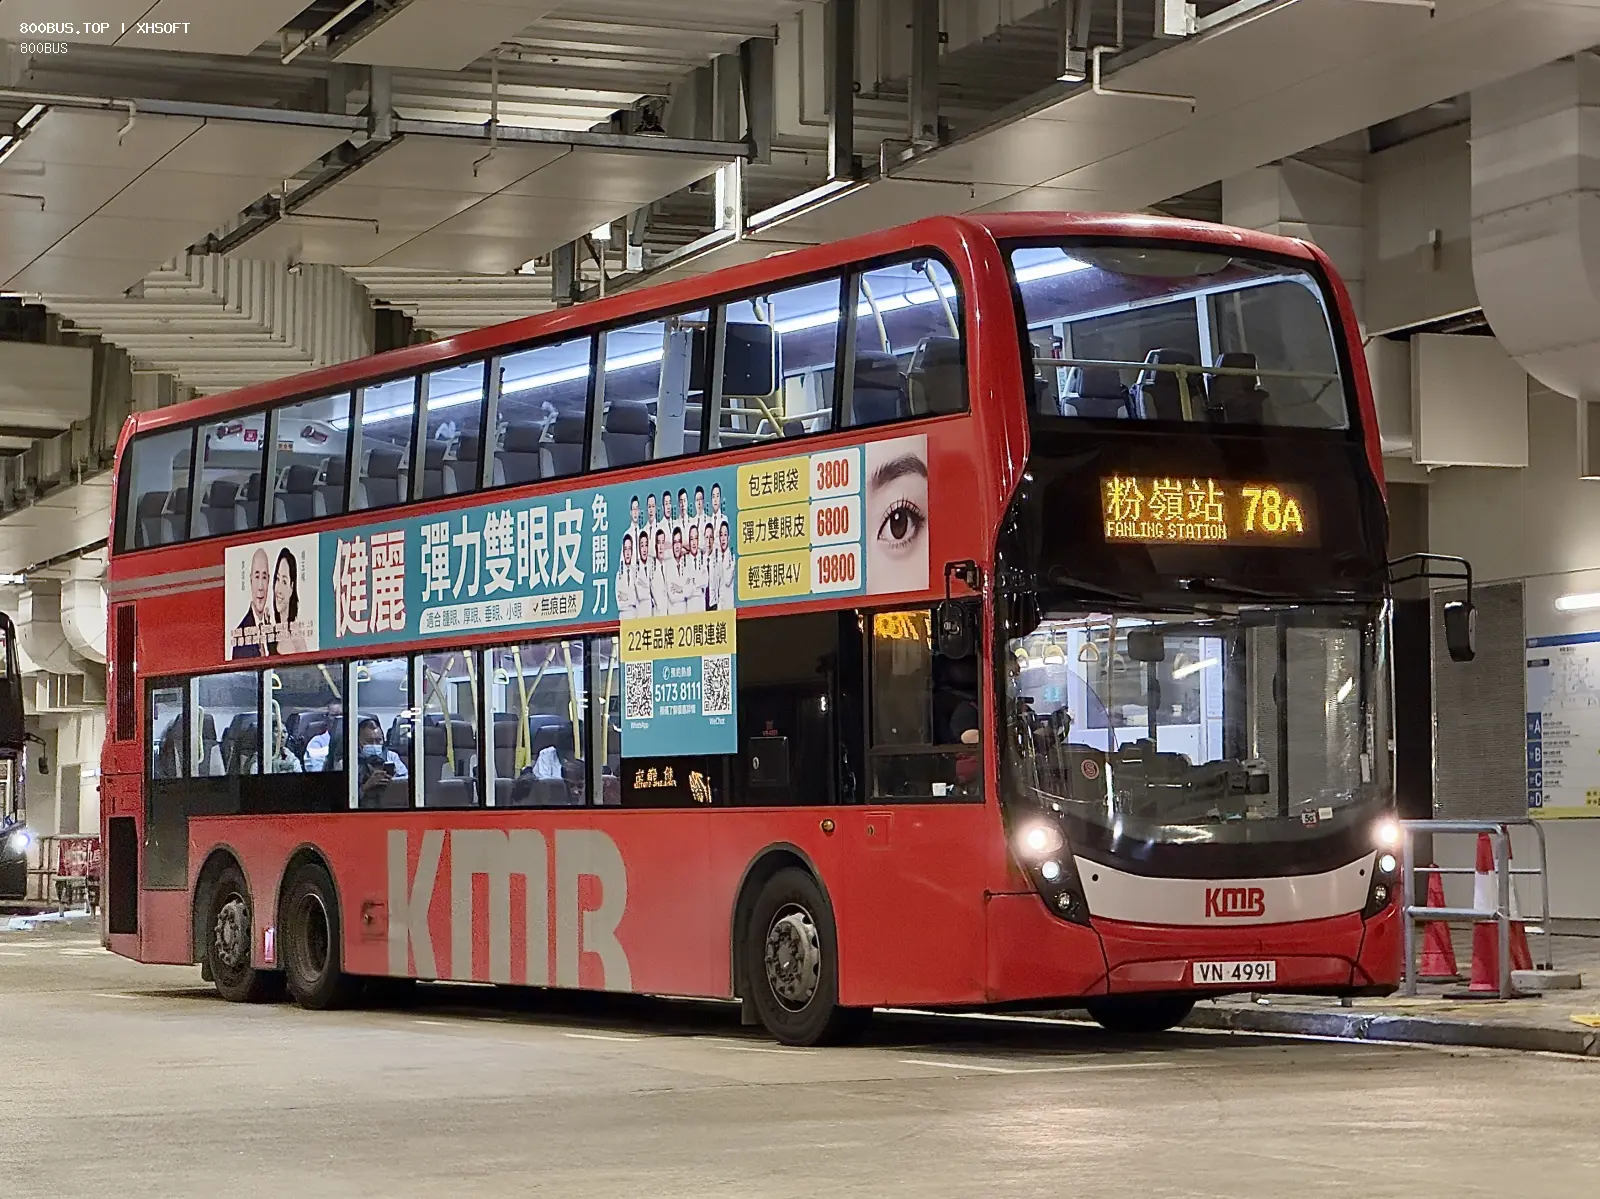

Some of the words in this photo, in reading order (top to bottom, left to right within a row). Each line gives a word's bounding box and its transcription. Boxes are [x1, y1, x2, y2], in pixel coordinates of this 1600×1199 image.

[748, 468, 799, 498] 包去眼袋
[816, 459, 849, 491] 3800
[1106, 474, 1224, 522] 粉嶺站
[1242, 487, 1304, 533] 78A
[742, 514, 806, 545] 彈力雙眼皮
[816, 505, 849, 537] 6800
[1106, 520, 1163, 537] FANLING
[1167, 523, 1227, 540] STATION
[420, 498, 585, 602] 彈力雙眼皮
[591, 493, 609, 616] 免開刀
[332, 529, 408, 638] 健麗
[748, 563, 802, 590] 輕薄眼4V
[816, 553, 855, 585] 19800
[540, 594, 577, 617] 無痕自然
[627, 626, 675, 652] 22年品牌
[678, 621, 728, 648] 20間連鎖
[655, 682, 678, 703] 5173
[680, 681, 701, 702] 8111
[1205, 887, 1266, 918] KMB
[1199, 963, 1223, 982] VN
[1231, 962, 1271, 982] 4991
